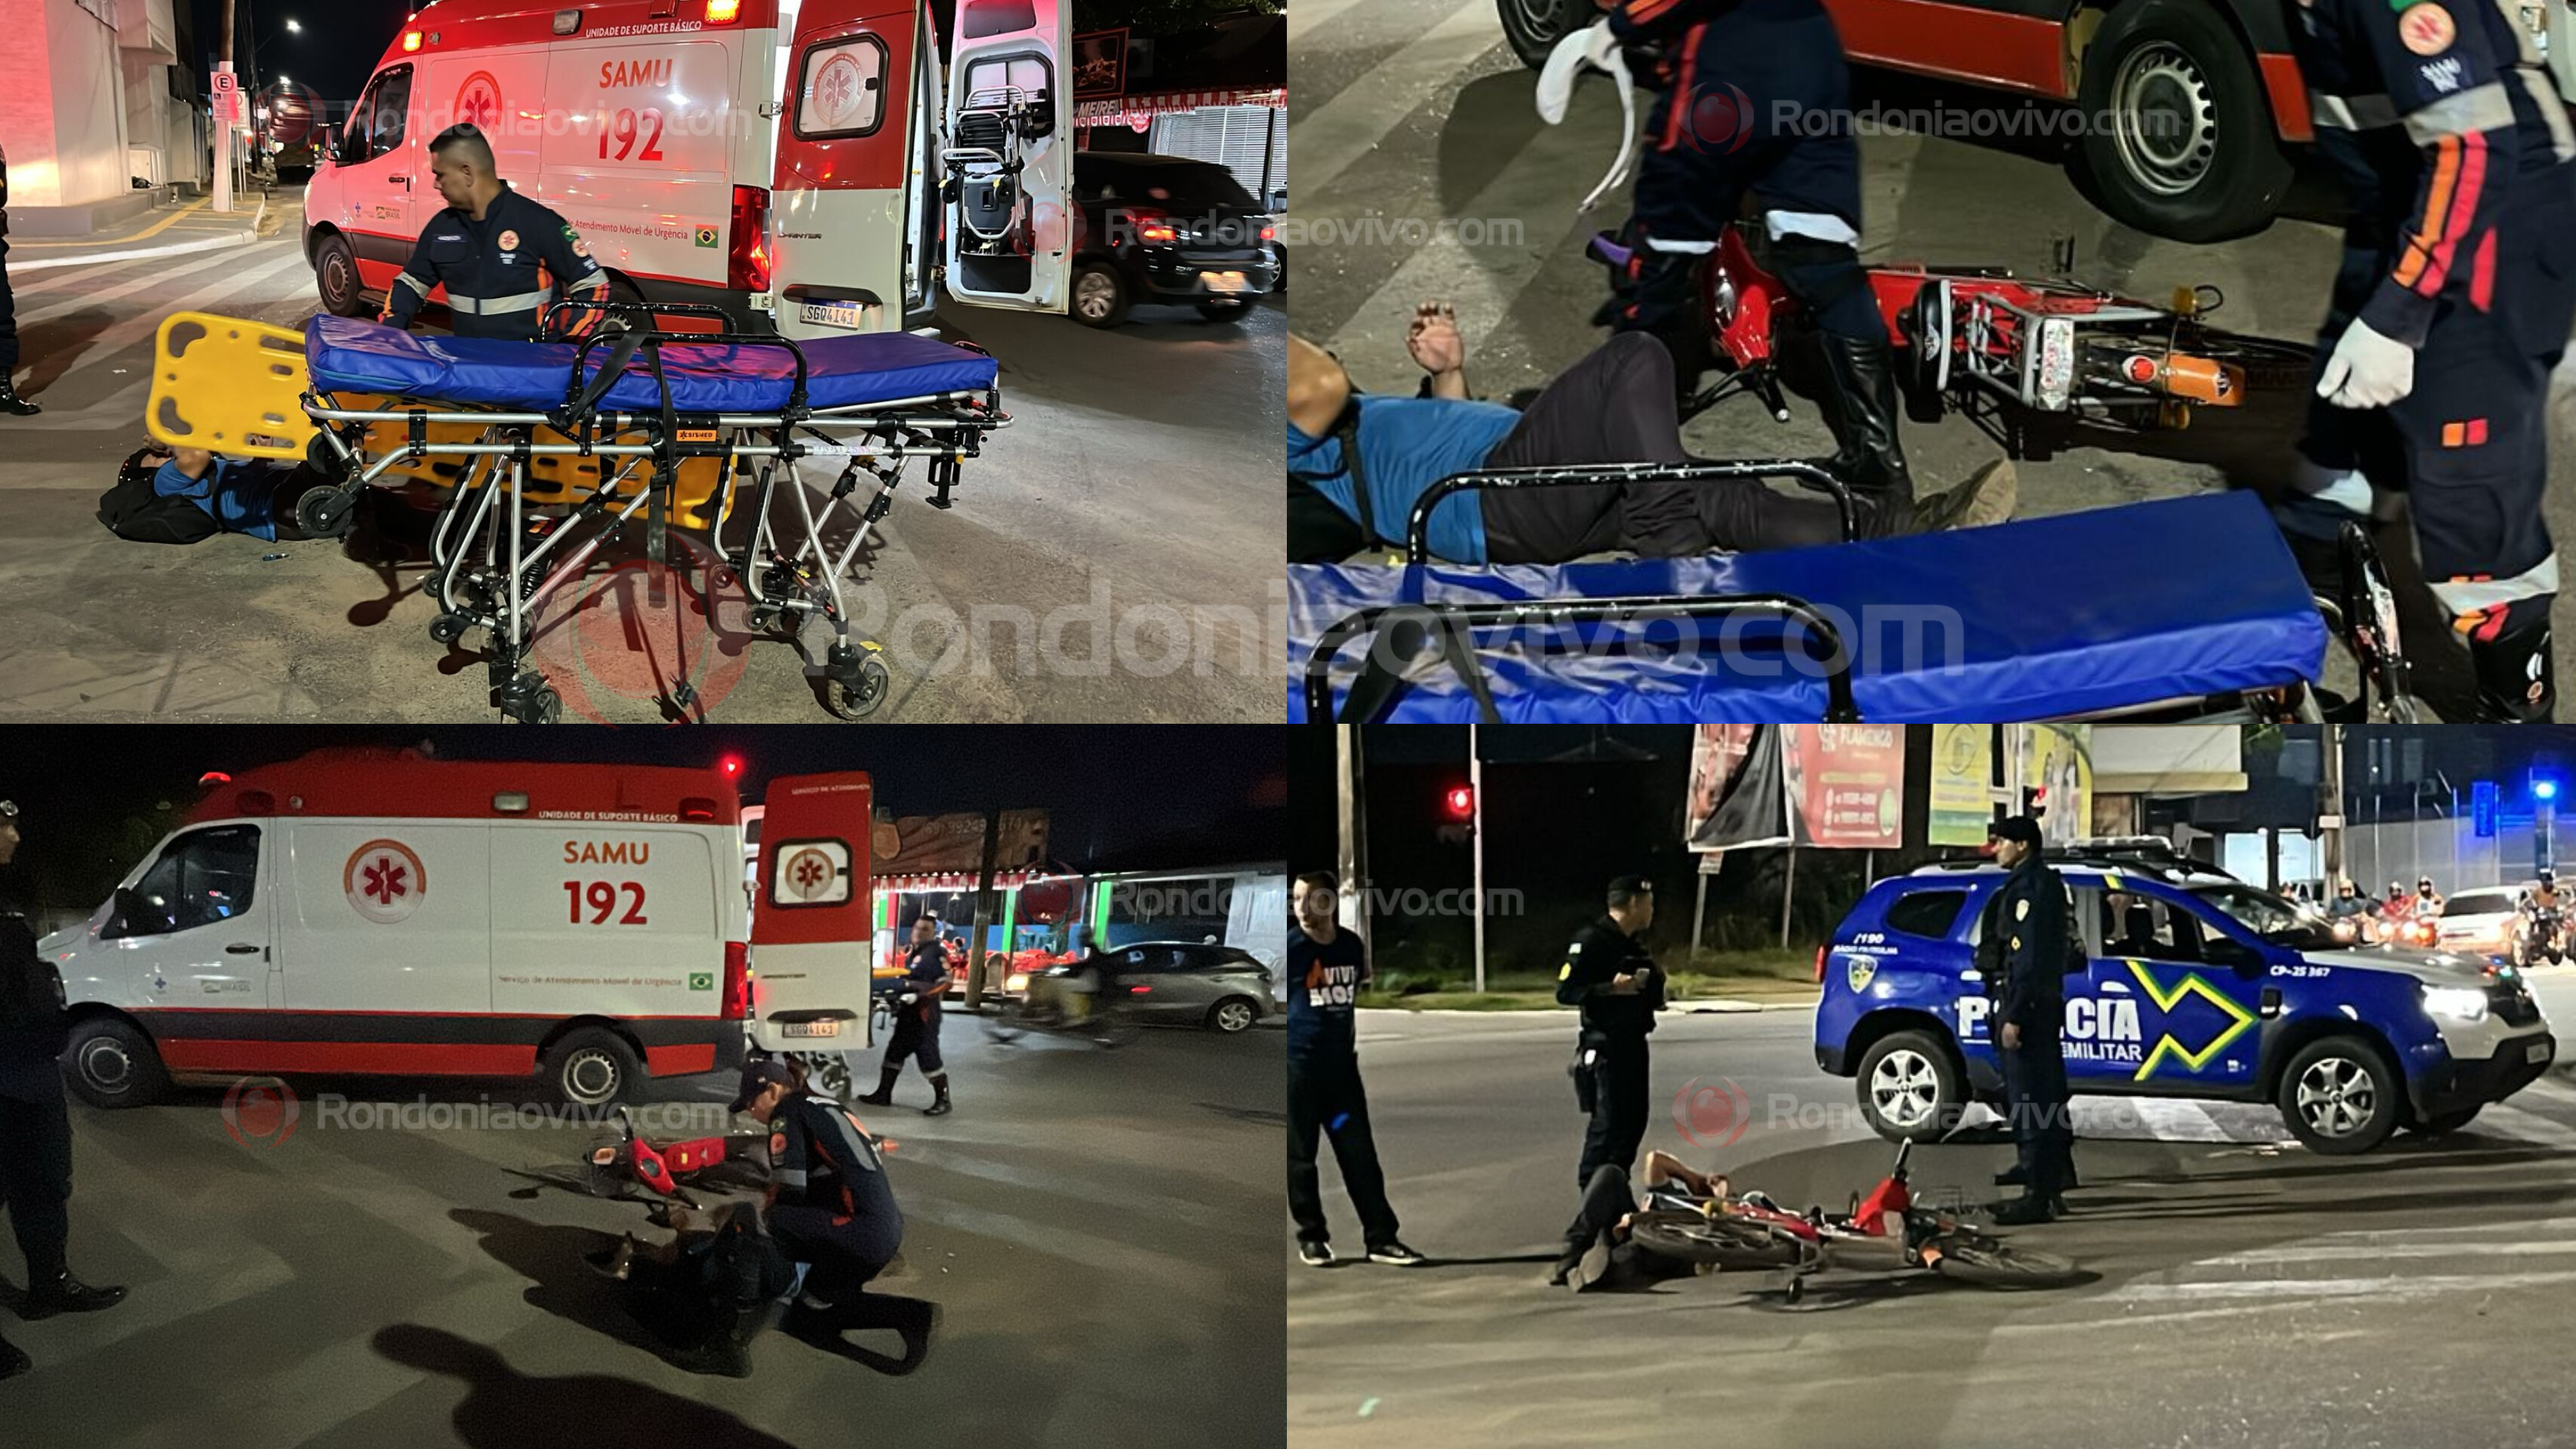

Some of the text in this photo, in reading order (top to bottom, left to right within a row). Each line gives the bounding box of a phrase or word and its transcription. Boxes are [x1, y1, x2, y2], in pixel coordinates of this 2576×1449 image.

[586, 18, 702, 38] UNIDADE DE SUPORTE BÁSICO
[220, 78, 229, 88] E
[599, 58, 673, 88] SAMU
[598, 107, 663, 162] 192
[575, 220, 618, 232] Atendimento
[620, 223, 642, 235] Móvel
[643, 226, 653, 236] de
[655, 227, 688, 240] Urgência
[539, 811, 679, 823] UNIDADE DE SUPORTE BÁSICO
[564, 841, 649, 866] SAMU
[564, 881, 648, 925] 192
[2068, 1041, 2143, 1062] MILITAR
